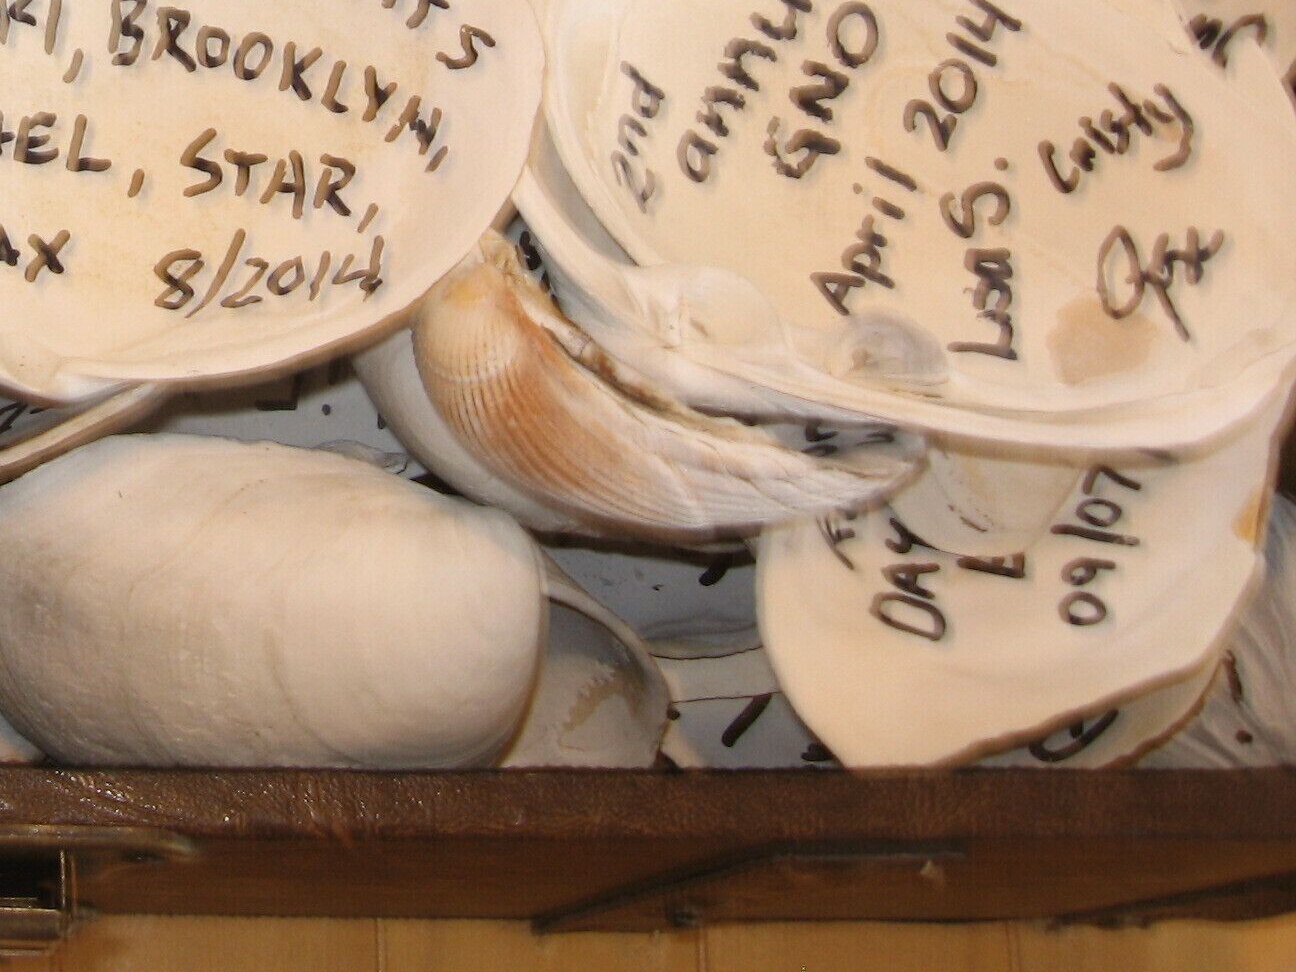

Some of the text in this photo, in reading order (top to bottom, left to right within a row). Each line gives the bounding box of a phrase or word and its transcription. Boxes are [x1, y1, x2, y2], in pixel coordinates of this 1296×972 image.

[610, 61, 664, 212] 2nd
[763, 0, 877, 178] GNO
[153, 229, 389, 317] 8/2014
[810, 157, 917, 315] April
[1050, 465, 1143, 628] 09/07
